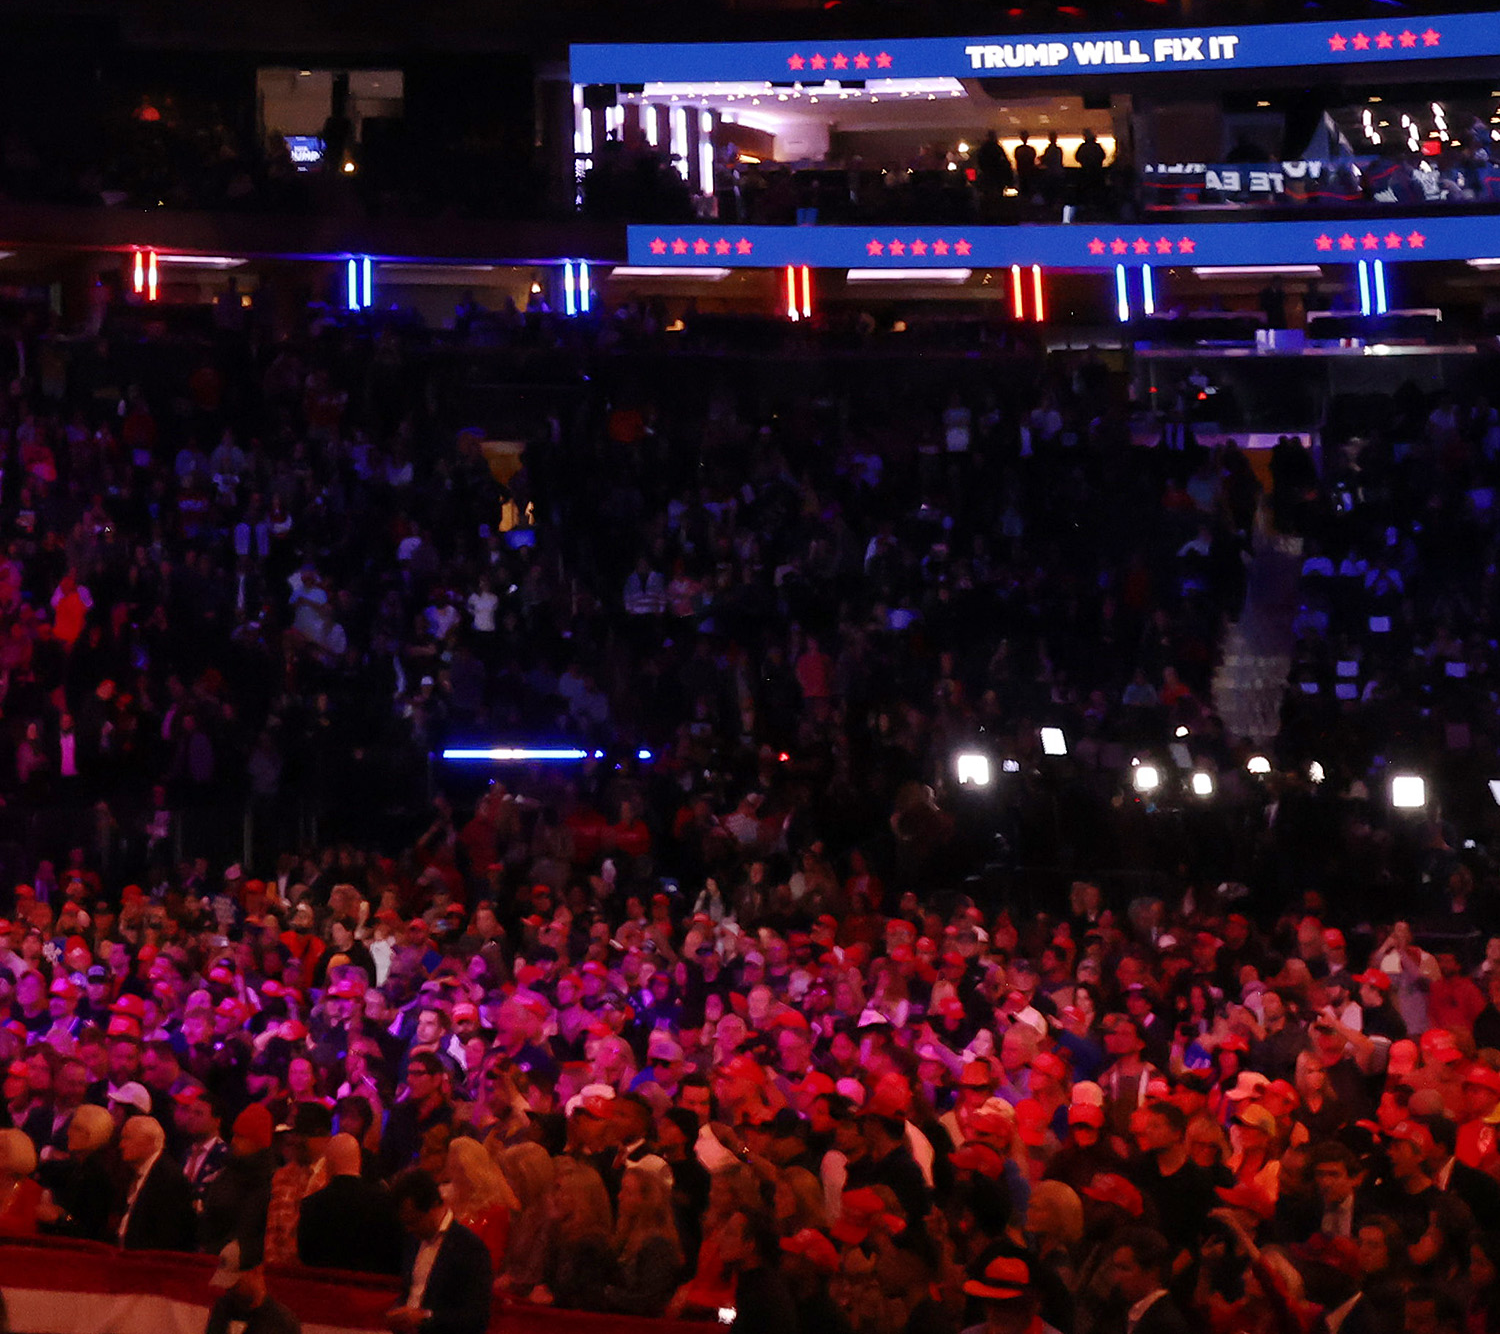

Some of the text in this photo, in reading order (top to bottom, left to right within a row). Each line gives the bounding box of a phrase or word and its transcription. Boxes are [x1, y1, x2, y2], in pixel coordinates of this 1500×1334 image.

[964, 35, 1240, 70] TRUMP WILL FIX IT
